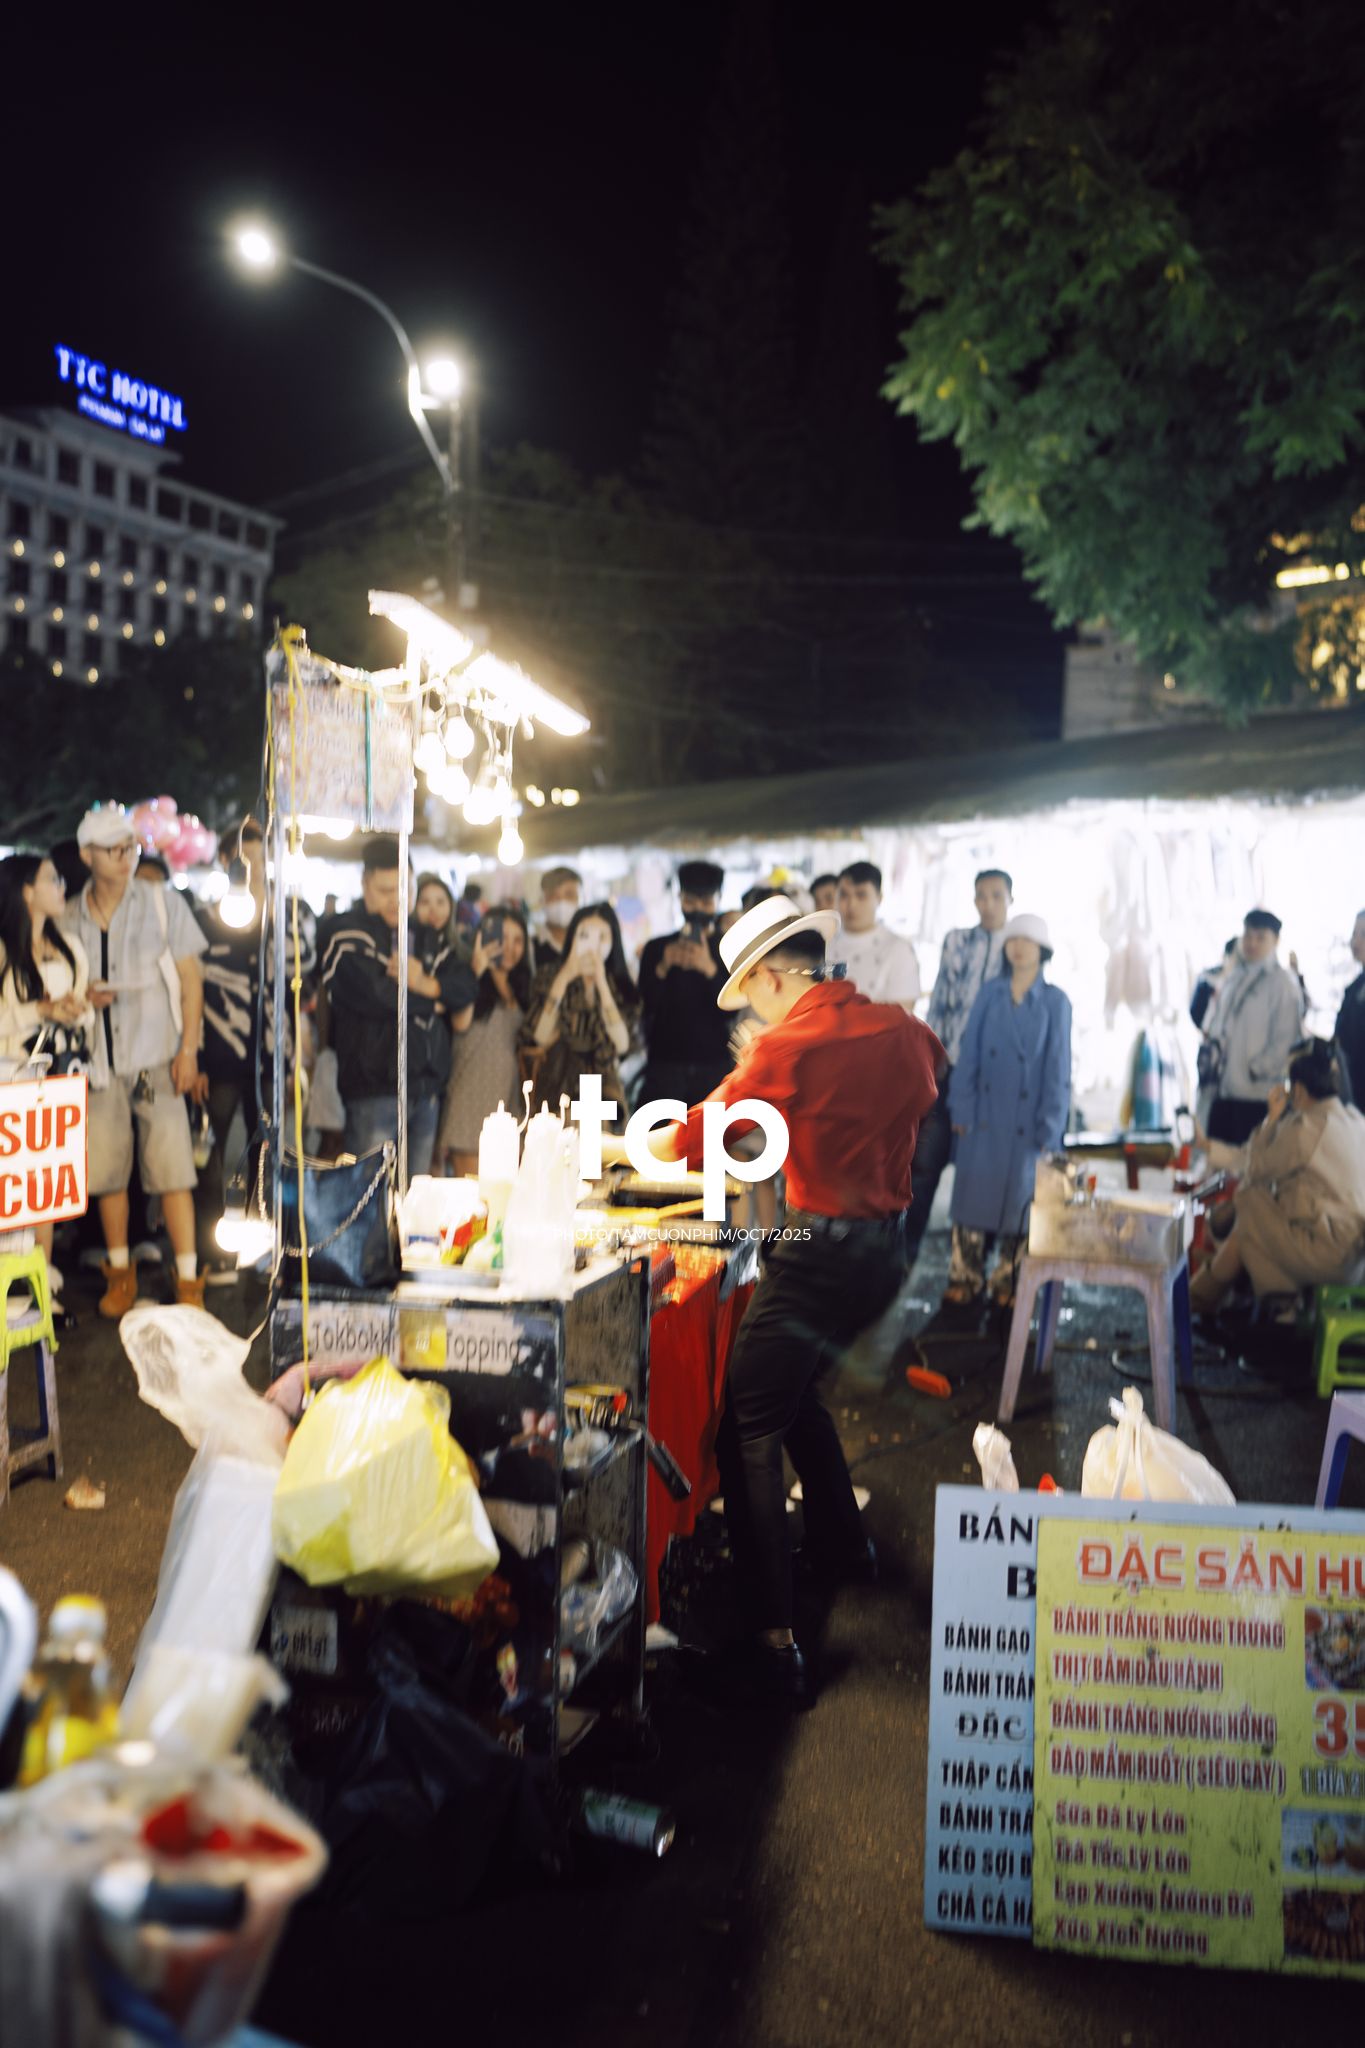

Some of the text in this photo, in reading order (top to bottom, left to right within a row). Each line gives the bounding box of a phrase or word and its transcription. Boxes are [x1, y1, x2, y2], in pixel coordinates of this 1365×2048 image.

[0, 1097, 81, 1157] SÚP
[0, 1164, 80, 1218] CUA
[1079, 1536, 1183, 1593] ĐẶC
[1198, 1538, 1303, 1594] SẢN
[944, 1616, 1030, 1661] BÁNH GẠO
[943, 1661, 990, 1697] BÁNH
[940, 1799, 992, 1832] BÁNH
